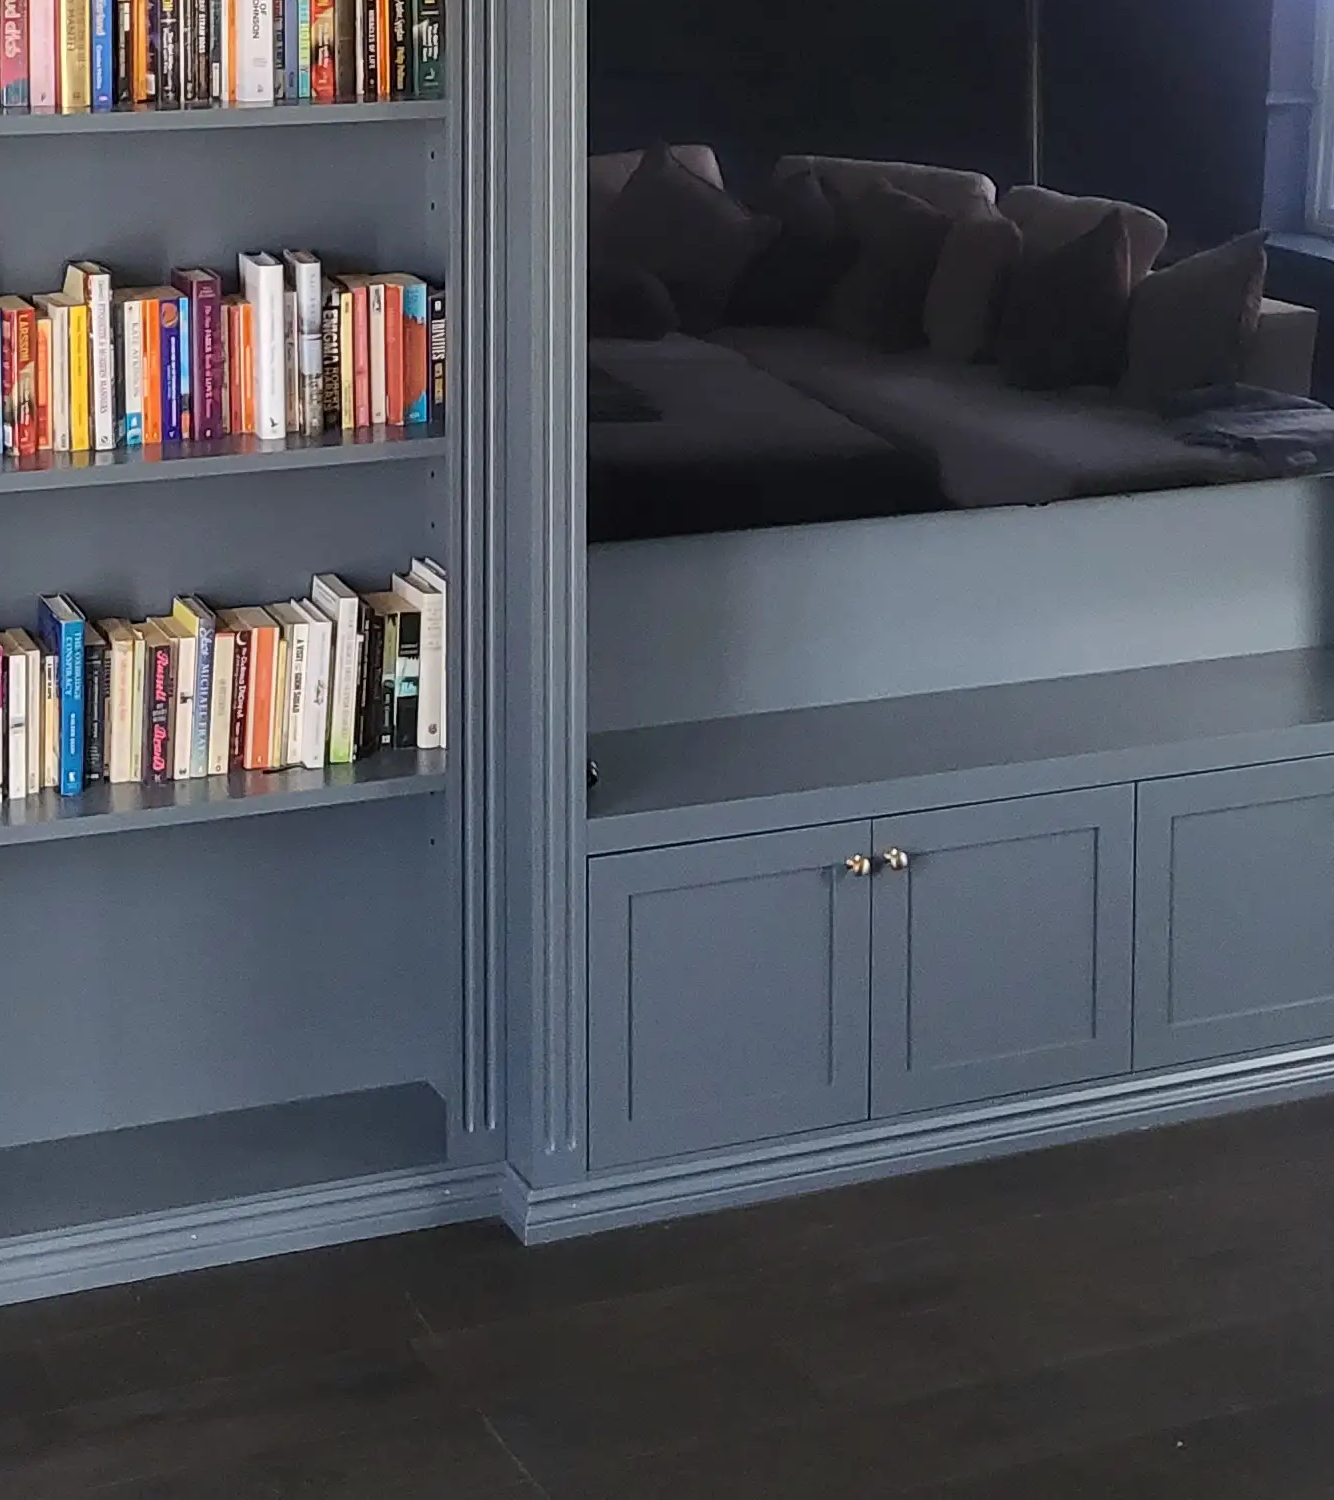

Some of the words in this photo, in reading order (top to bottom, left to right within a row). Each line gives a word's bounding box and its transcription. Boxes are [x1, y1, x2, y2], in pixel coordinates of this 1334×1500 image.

[259, 3, 267, 16] OF
[19, 314, 30, 362] LARSSON
[131, 322, 140, 344] KATE
[323, 309, 339, 364] ENIGMA
[131, 349, 140, 398] ATKINSON
[73, 632, 82, 650] THE
[295, 644, 305, 662] VISIT
[65, 636, 73, 696] CONSPIRACY
[73, 652, 82, 700] OXBRIDGE
[155, 650, 169, 702] Russell
[199, 664, 210, 716] MICHAEL
[153, 724, 167, 771] Brand
